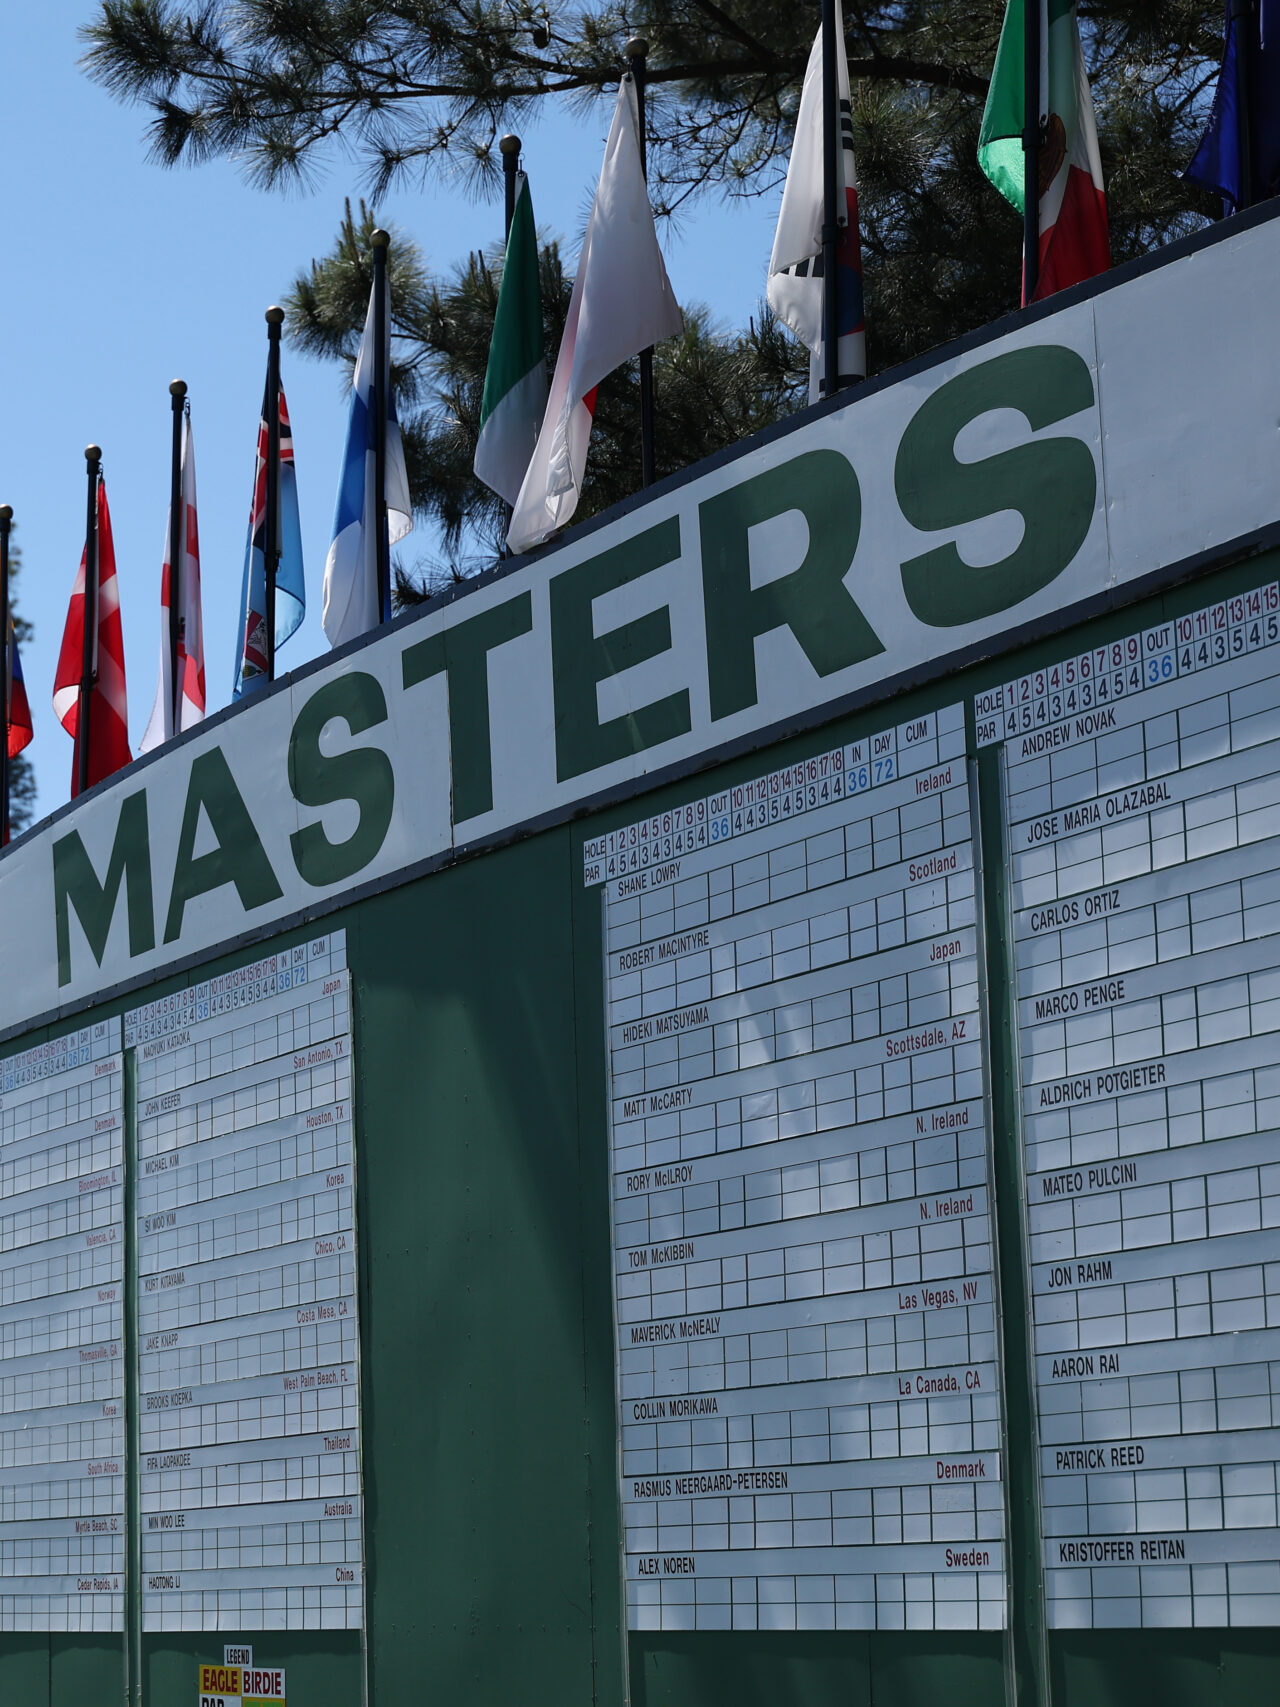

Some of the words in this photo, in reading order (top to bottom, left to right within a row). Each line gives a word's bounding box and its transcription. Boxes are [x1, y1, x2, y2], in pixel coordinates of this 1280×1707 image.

[976, 692, 1002, 715] HOLE
[1008, 685, 1013, 704] 1
[1021, 681, 1029, 700] 2
[1036, 674, 1044, 695] 3
[1051, 668, 1060, 687] 4
[1066, 662, 1074, 682] 5
[1081, 657, 1090, 677] 6
[1097, 651, 1105, 671] 7
[1113, 644, 1122, 666] 8
[1128, 639, 1137, 660] 9
[1147, 628, 1170, 651] OUT
[1178, 617, 1191, 642] 10
[1196, 613, 1208, 635] 11
[1212, 606, 1225, 630] 12
[1229, 599, 1243, 623] 13
[1246, 593, 1260, 616] 14
[1263, 585, 1278, 610] 15
[52, 345, 1096, 986] MASTERS
[977, 721, 996, 742] PAR
[1007, 712, 1016, 732] 4
[1022, 707, 1031, 727] 5
[1037, 701, 1046, 722] 4
[1053, 695, 1061, 716] 3
[1067, 690, 1076, 710] 4
[1083, 684, 1091, 705] 3
[1099, 679, 1108, 699] 4
[1114, 673, 1123, 693] 5
[1130, 667, 1139, 687] 4
[1149, 655, 1172, 683] 36
[1182, 649, 1191, 669] 4
[1199, 642, 1208, 663] 4
[1215, 636, 1224, 659] 3
[1233, 629, 1243, 652] 5
[1250, 623, 1259, 644] 4
[1268, 617, 1278, 639] 5
[1022, 724, 1070, 757] ANDREW
[1076, 708, 1116, 737] NOVAK
[585, 841, 605, 860] HOLE
[711, 795, 727, 815] OUT
[852, 745, 861, 763] IN
[875, 734, 891, 755] DAY
[906, 720, 927, 742] CUM
[915, 767, 951, 795] Ireland
[586, 865, 600, 884] PAR
[712, 818, 728, 841] 36
[849, 767, 868, 791] 36
[875, 758, 894, 782] 72
[1027, 818, 1058, 843] JOSE
[1064, 804, 1100, 831] MARIA
[1106, 782, 1171, 818] OLAZABAL
[619, 872, 647, 896] SHANE
[651, 861, 681, 886] LOWRY
[909, 851, 956, 882] Scotland
[1031, 903, 1079, 931] CARLOS
[1085, 890, 1120, 916] ORTIZ
[620, 945, 655, 970] ROBERT
[658, 930, 709, 960] MACINTYRE
[930, 939, 961, 961] Japan
[322, 979, 341, 996] Japan
[1036, 992, 1078, 1019] MARCO
[1084, 980, 1125, 1008] PENGE
[623, 1022, 653, 1043] HIDEKI
[656, 1007, 709, 1032] MATSUYAMA
[886, 1026, 947, 1057] Scottsdale,
[952, 1021, 965, 1039] AZ
[294, 1055, 305, 1069] San
[308, 1047, 332, 1066] Antonio,
[334, 1040, 343, 1054] TX
[1040, 1079, 1091, 1106] ALDRICH
[1097, 1064, 1165, 1096] POTGIETER
[145, 1102, 159, 1117] JOHN
[161, 1093, 180, 1110] KEEFER
[624, 1099, 647, 1117] MATT
[650, 1088, 692, 1111] McCARTY
[306, 1111, 333, 1129] Houston,
[336, 1105, 344, 1119] TX
[917, 1116, 926, 1134] N.
[932, 1107, 969, 1129] Ireland
[146, 1159, 168, 1174] MICHAEL
[170, 1154, 179, 1167] KIM
[326, 1172, 345, 1188] Korea
[627, 1175, 650, 1192] RORY
[654, 1165, 692, 1186] McILROY
[1043, 1173, 1082, 1197] MATEO
[1089, 1163, 1137, 1189] PULCINI
[921, 1202, 931, 1219] N.
[936, 1194, 973, 1217] Ireland
[145, 1220, 151, 1233] SI
[153, 1216, 165, 1229] WOO
[166, 1213, 176, 1226] KIM
[315, 1240, 334, 1256] Chico,
[337, 1236, 346, 1249] CA
[629, 1251, 648, 1267] TOM
[651, 1242, 694, 1264] McKIBBIN
[145, 1279, 158, 1291] KURT
[161, 1271, 185, 1287] KITAYAMA
[1049, 1267, 1071, 1287] JON
[1078, 1261, 1112, 1282] RAHM
[899, 1292, 917, 1310] Las
[922, 1286, 959, 1308] Vegas,
[963, 1282, 978, 1300] NV
[297, 1309, 315, 1323] Costa
[318, 1305, 336, 1320] Mesa,
[339, 1302, 347, 1315] CA
[146, 1337, 159, 1351] JAKE
[161, 1333, 178, 1347] KNAPP
[631, 1323, 676, 1343] MAVERICK
[679, 1317, 720, 1339] McNEALY
[1052, 1356, 1093, 1378] AARON
[1100, 1353, 1119, 1373] RAI
[284, 1376, 298, 1391] West
[301, 1373, 315, 1388] Palm
[318, 1370, 339, 1385] Beach,
[341, 1368, 347, 1381] FL
[899, 1378, 911, 1395] La
[916, 1375, 961, 1393] Canada,
[965, 1371, 980, 1388] CA
[103, 1405, 116, 1416] Korea
[147, 1395, 169, 1410] BROOKS
[171, 1391, 192, 1405] KOEPKA
[634, 1403, 665, 1420] COLLIN
[669, 1398, 718, 1418] MORIKAWA
[324, 1435, 350, 1451] Thailand
[88, 1463, 102, 1475] South
[104, 1460, 118, 1472] Africa
[937, 1459, 985, 1479] Denmark
[1057, 1449, 1105, 1470] PATRICK
[1111, 1446, 1144, 1466] REED
[634, 1480, 671, 1498] RASMUS
[675, 1471, 788, 1496] NEERGAARD-PETERSEN
[325, 1501, 352, 1516] Australia
[76, 1521, 90, 1534] Myrtle
[92, 1520, 108, 1532] Beach,
[111, 1519, 117, 1530] SC
[148, 1517, 158, 1529] MIN
[161, 1516, 173, 1528] WOO
[175, 1515, 185, 1527] LEE
[945, 1548, 989, 1567] Sweden
[1060, 1542, 1134, 1562] KRISTOFFER
[1140, 1540, 1185, 1559] REITAN
[336, 1568, 354, 1581] China
[638, 1558, 659, 1575] ALEX
[664, 1556, 695, 1573] NOREN
[77, 1579, 91, 1590] Cedar
[94, 1578, 111, 1591] Rapids,
[113, 1578, 118, 1590] IA
[149, 1577, 173, 1589] HAOTONG
[176, 1576, 180, 1588] LI
[227, 1649, 249, 1664] LEGEND
[203, 1669, 238, 1692] EAGLE
[244, 1671, 281, 1695] BIRDIE
